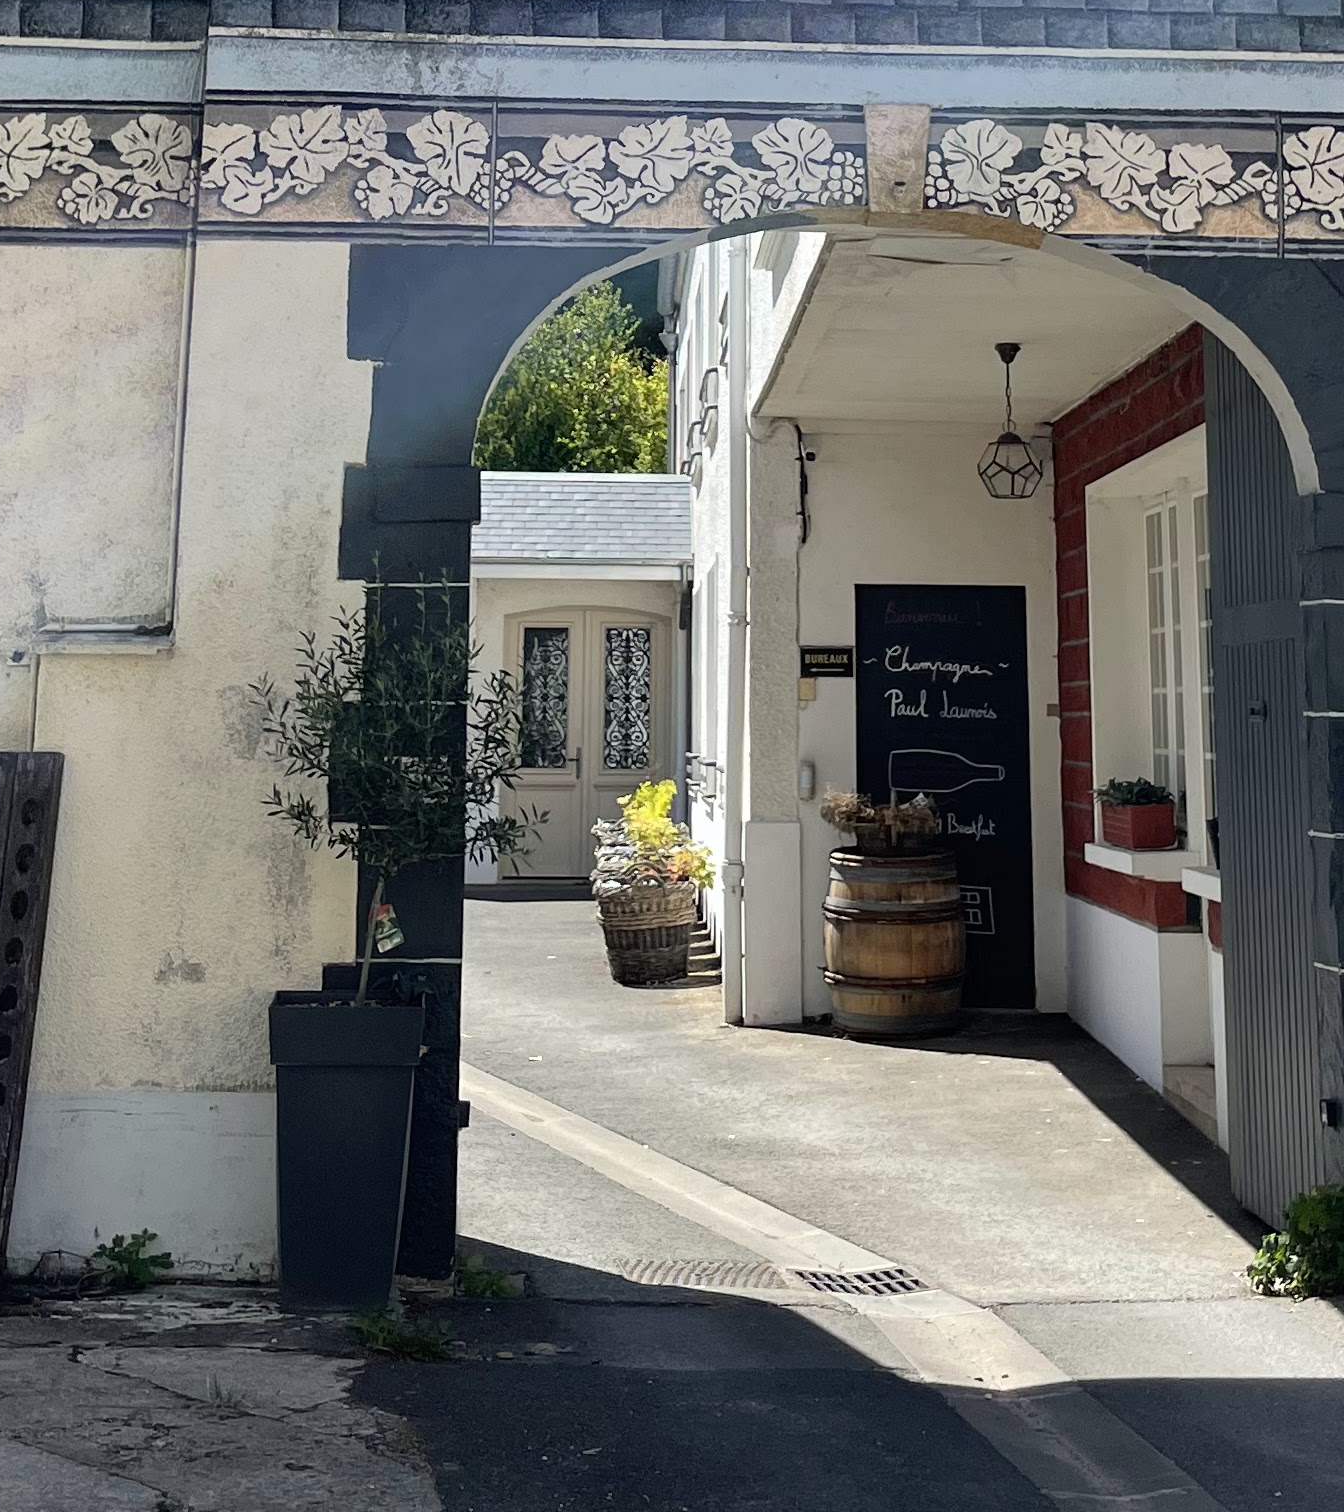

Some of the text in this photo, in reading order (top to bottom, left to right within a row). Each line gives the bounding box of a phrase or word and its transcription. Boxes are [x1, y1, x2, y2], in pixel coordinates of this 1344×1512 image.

[805, 653, 849, 664] BUREAUX
[884, 644, 994, 683] Champagne
[884, 688, 997, 719] Paul Launois
